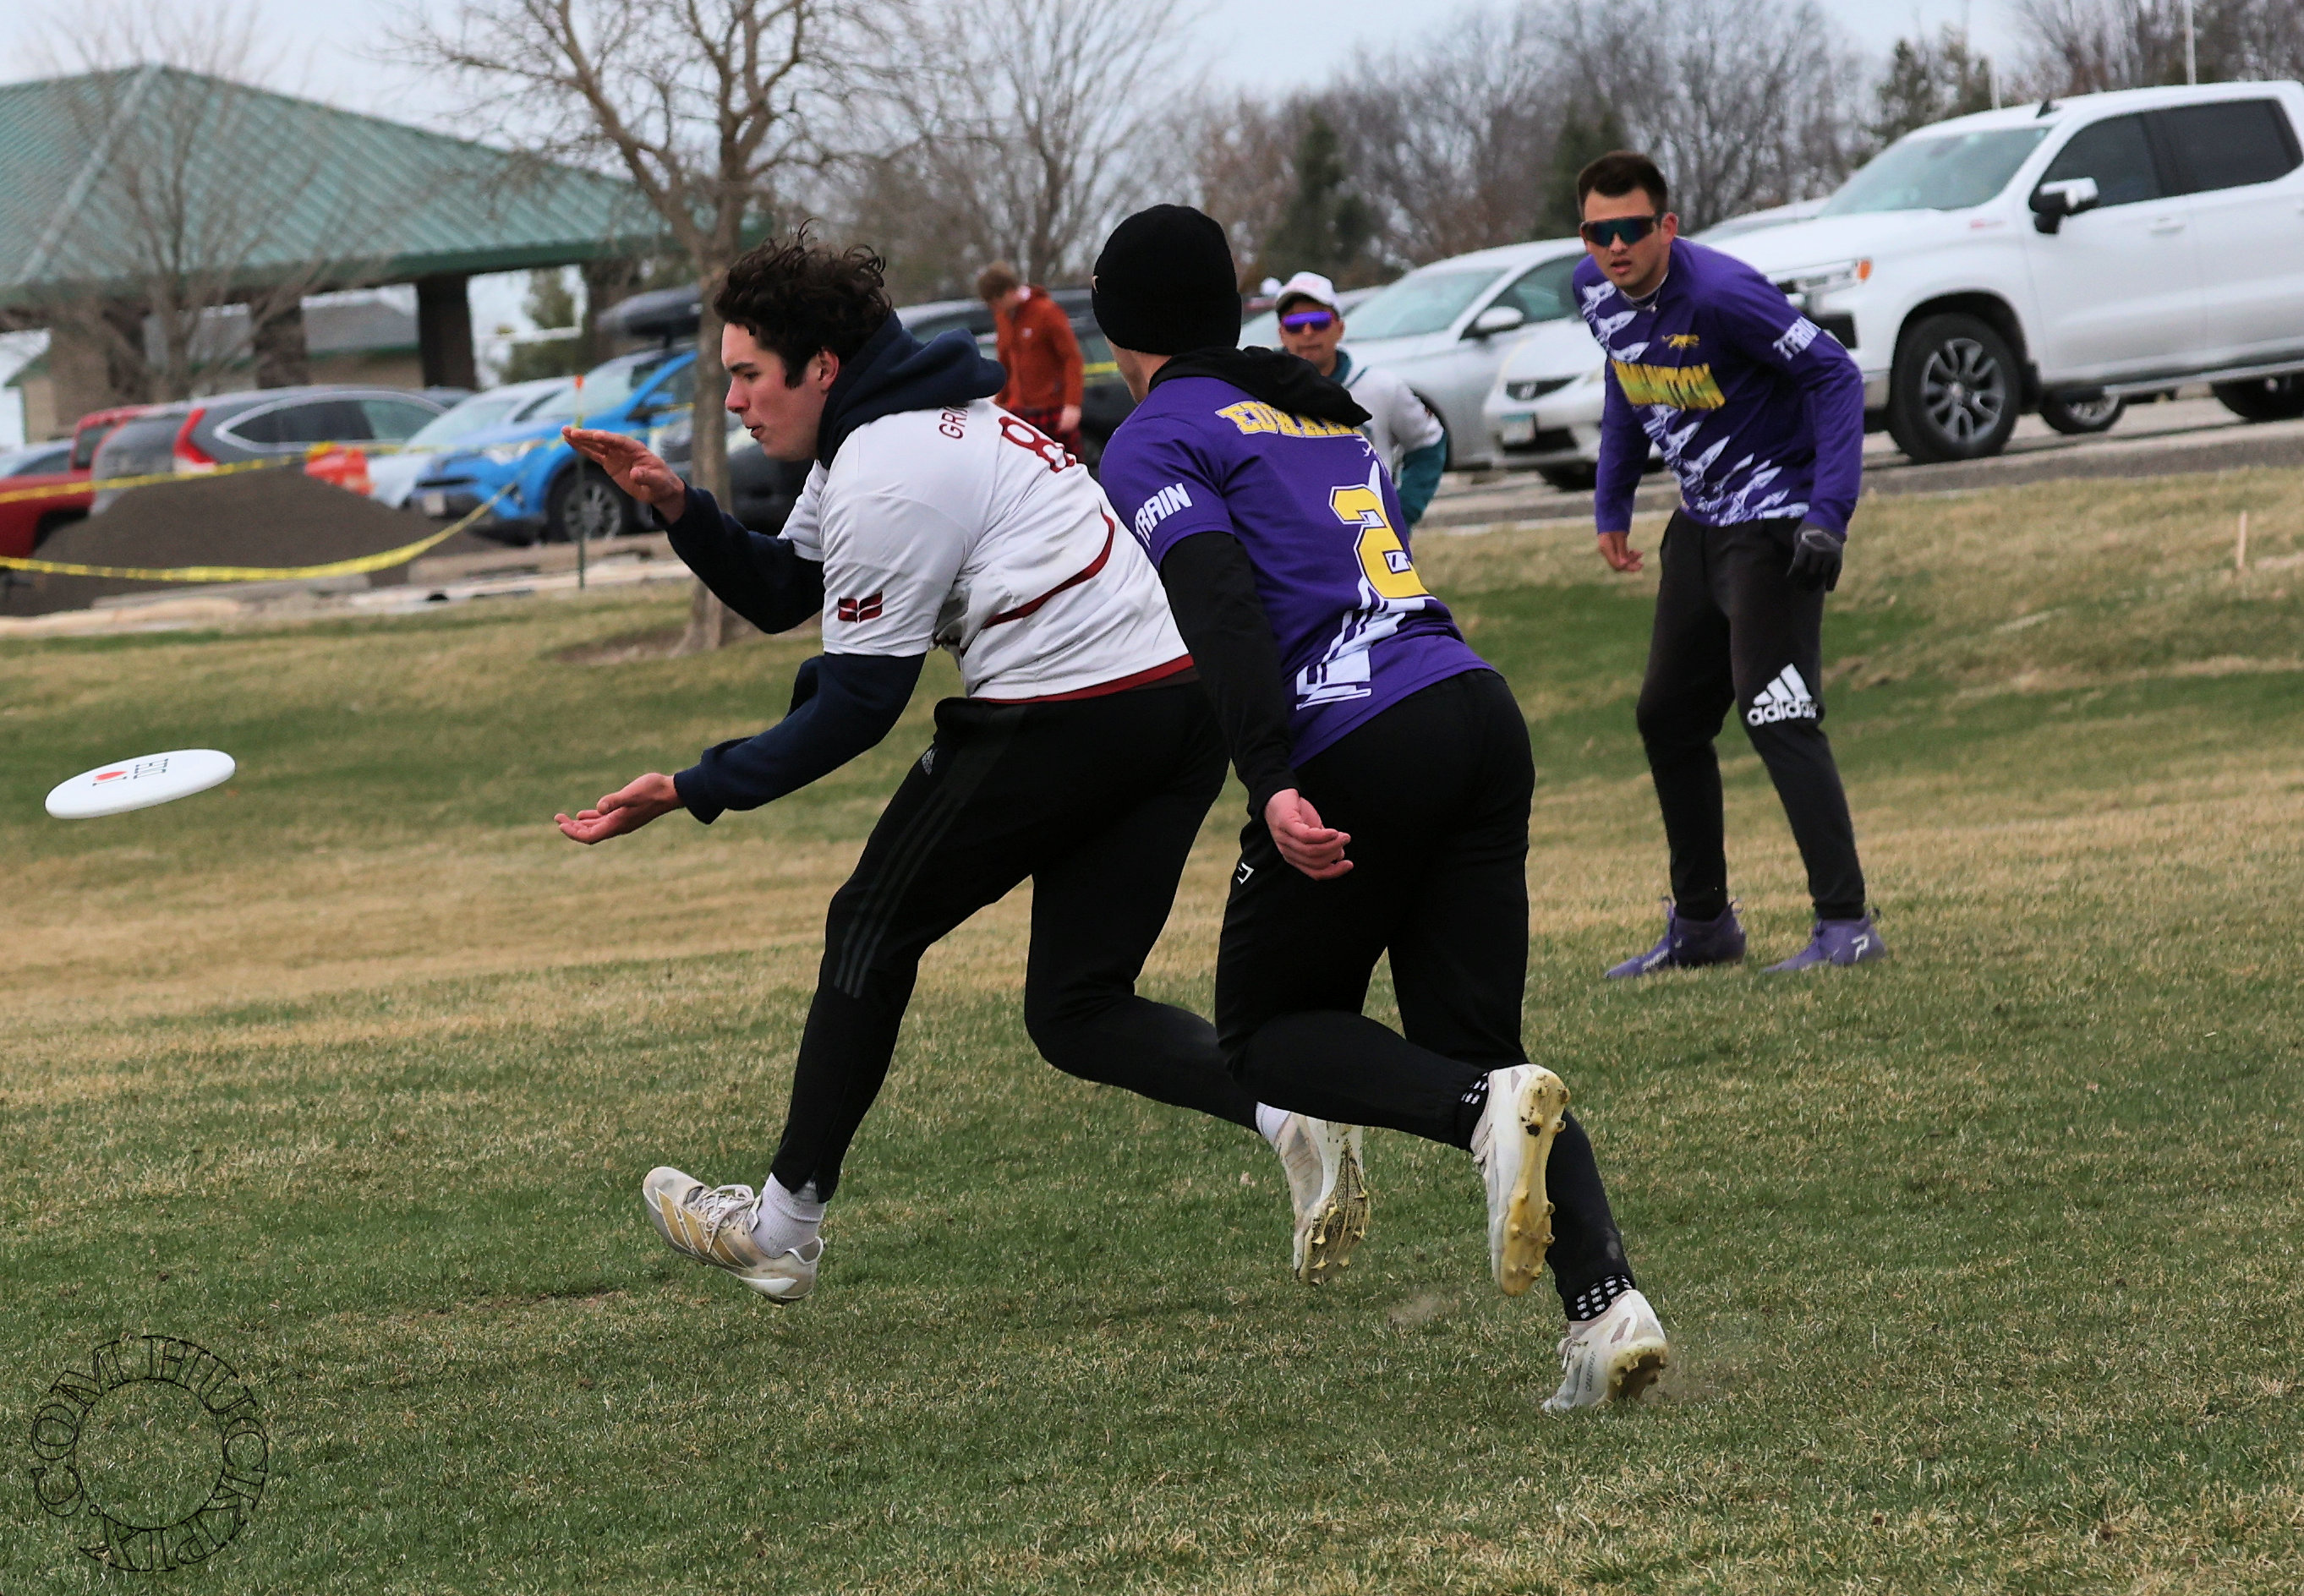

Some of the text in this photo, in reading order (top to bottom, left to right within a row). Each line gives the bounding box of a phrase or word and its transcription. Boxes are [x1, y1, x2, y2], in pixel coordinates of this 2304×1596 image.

[1135, 483, 1193, 549] TRAIN
[1328, 483, 1435, 599] 2
[1746, 697, 1818, 726] adidas
